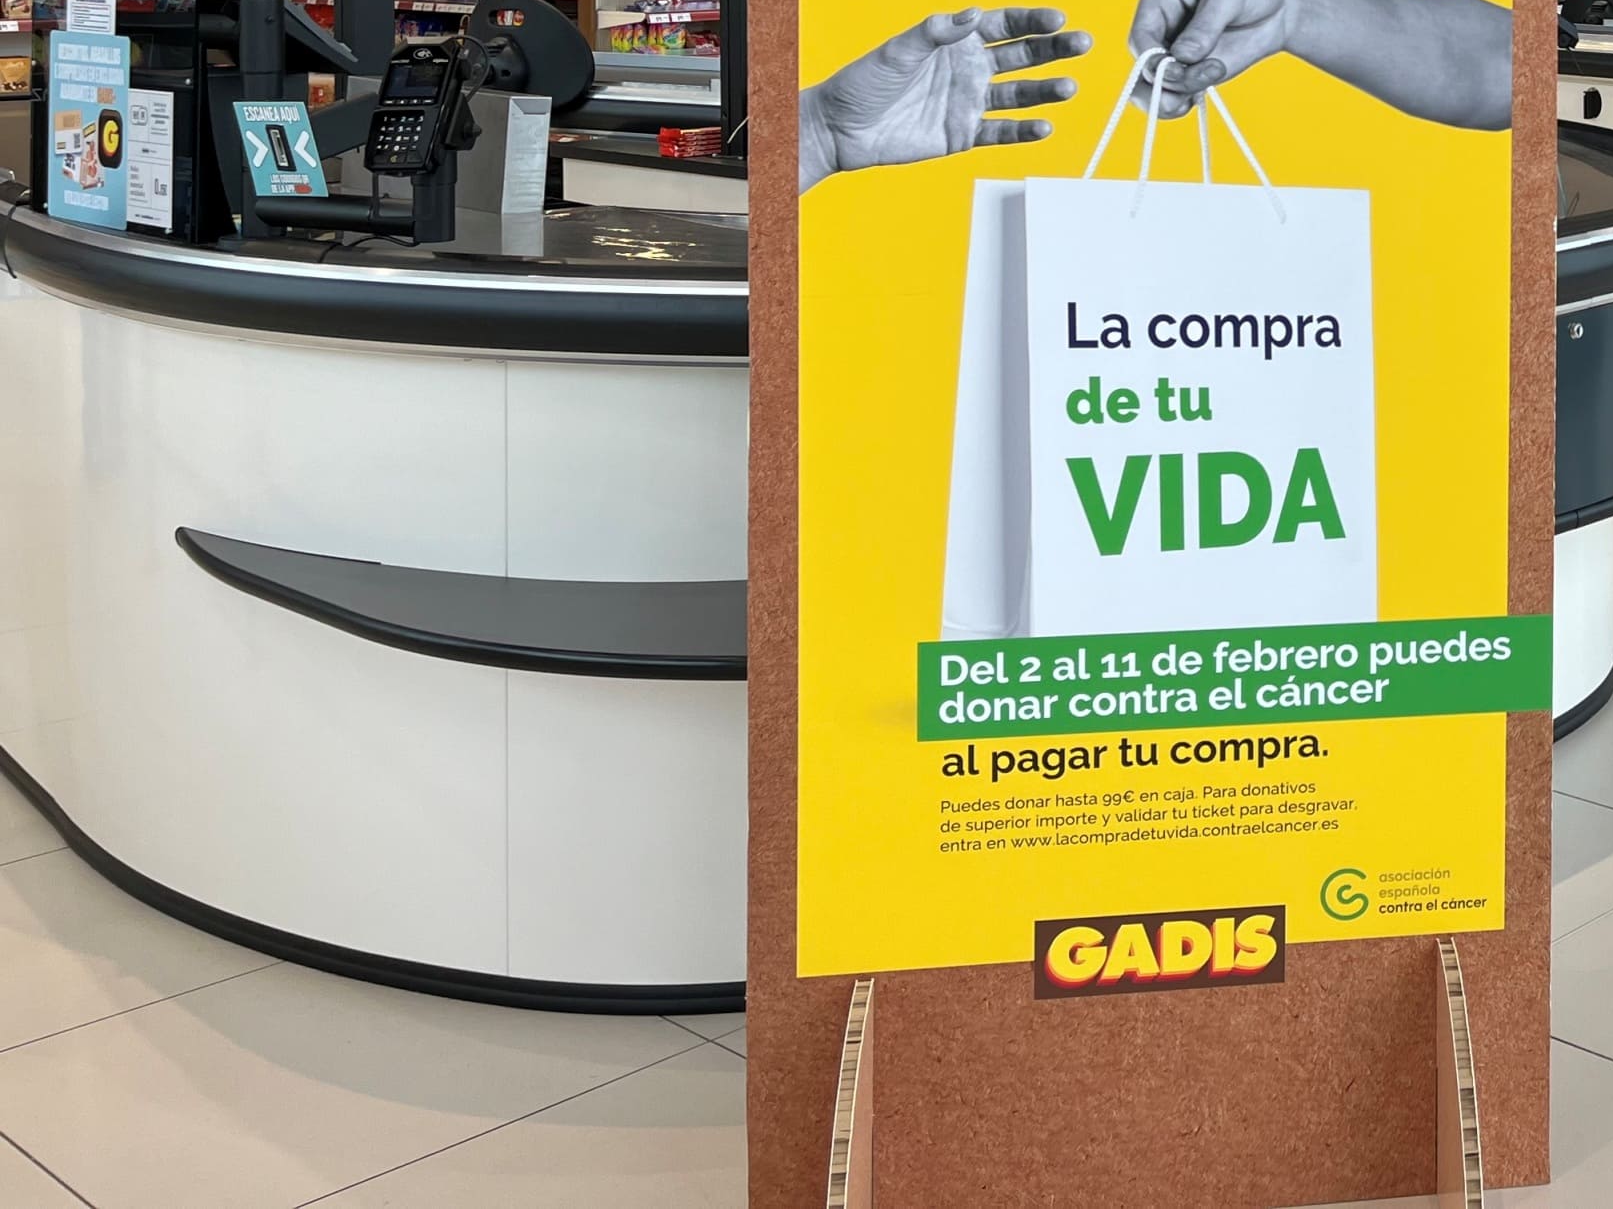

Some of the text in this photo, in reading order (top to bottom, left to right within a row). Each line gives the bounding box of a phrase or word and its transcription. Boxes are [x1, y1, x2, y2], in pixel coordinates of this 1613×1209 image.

[1067, 302, 1342, 360] La compra
[1066, 376, 1213, 425] de tu
[1065, 447, 1346, 557] VIDA
[939, 631, 1512, 687] Del 2 al 11 de febrero puedes
[938, 674, 1390, 725] donar contra el cáncer
[940, 728, 1330, 781] al pagar tu compra.
[940, 781, 1317, 814] Puedes donar hasta 99€ en caja. Para donativos
[940, 819, 961, 833] de
[965, 814, 1032, 835] superior
[1035, 810, 1098, 831] importe
[1101, 812, 1111, 827] y
[1115, 806, 1169, 825] validar
[1172, 806, 1188, 820] tu
[1192, 802, 1236, 819] ticket
[1239, 802, 1275, 818] para
[939, 816, 1340, 853] entra en www.lacompradetuvida.contraelcancer.es
[1378, 868, 1451, 883] asociación
[1378, 883, 1441, 900] española
[1378, 897, 1488, 914] contra el cáncer
[1045, 915, 1278, 987] GADIS
